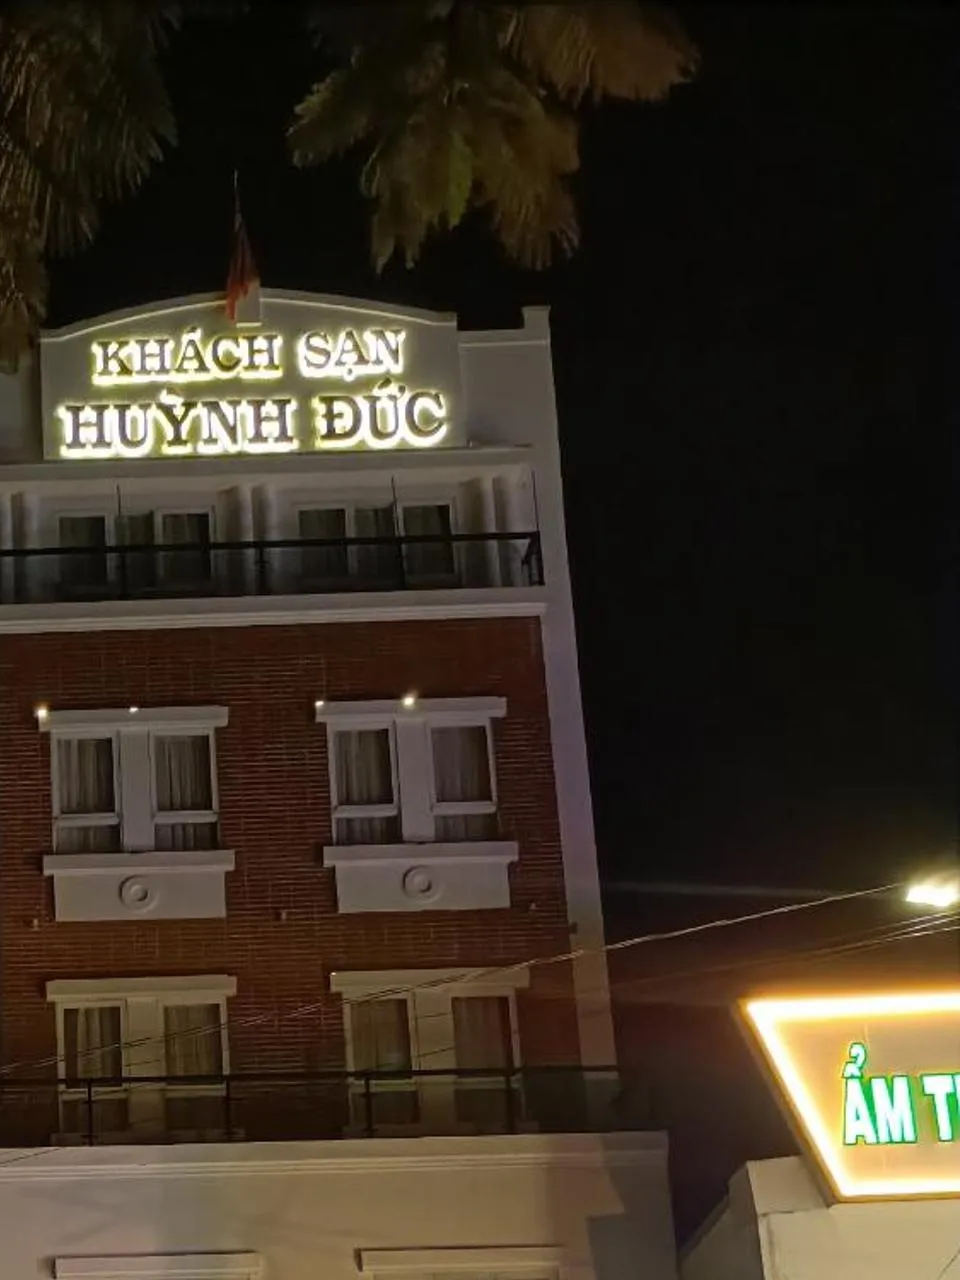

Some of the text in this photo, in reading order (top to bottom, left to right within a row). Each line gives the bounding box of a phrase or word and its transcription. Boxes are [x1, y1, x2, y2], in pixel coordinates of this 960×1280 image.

[94, 327, 405, 383] KHÁCH SẠN
[59, 378, 447, 456] HUỲNH ĐỨC
[842, 1042, 960, 1146] ẨM T
